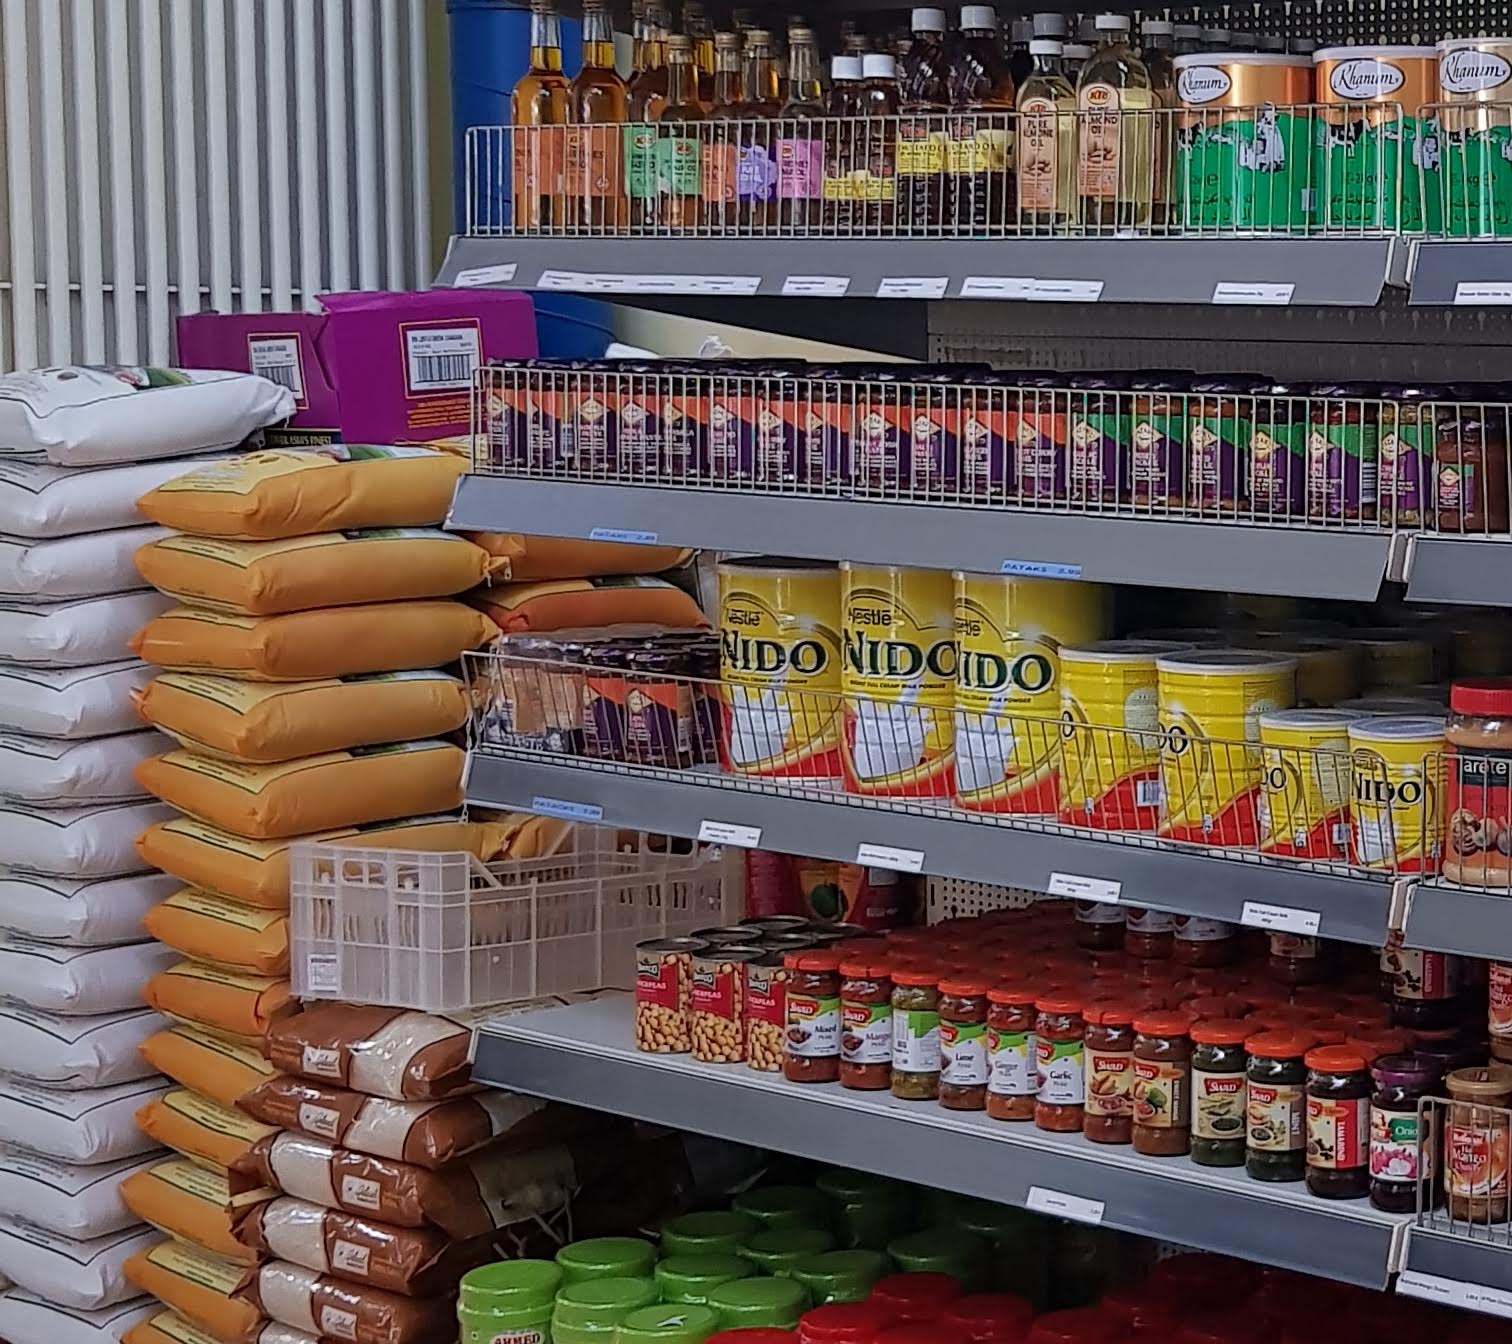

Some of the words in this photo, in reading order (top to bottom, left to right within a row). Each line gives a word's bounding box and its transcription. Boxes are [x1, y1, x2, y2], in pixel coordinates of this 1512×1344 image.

[1180, 73, 1230, 98] Khanum
[1334, 63, 1402, 90] Khanum
[722, 632, 830, 676] NIDO
[843, 633, 957, 680] NIDO
[957, 644, 1055, 695] IDO
[1350, 769, 1424, 806] NIDO
[814, 1024, 838, 1035] Mixed
[865, 1031, 892, 1043] Mango
[954, 1052, 975, 1064] Lime
[1048, 1069, 1073, 1081] Garlic
